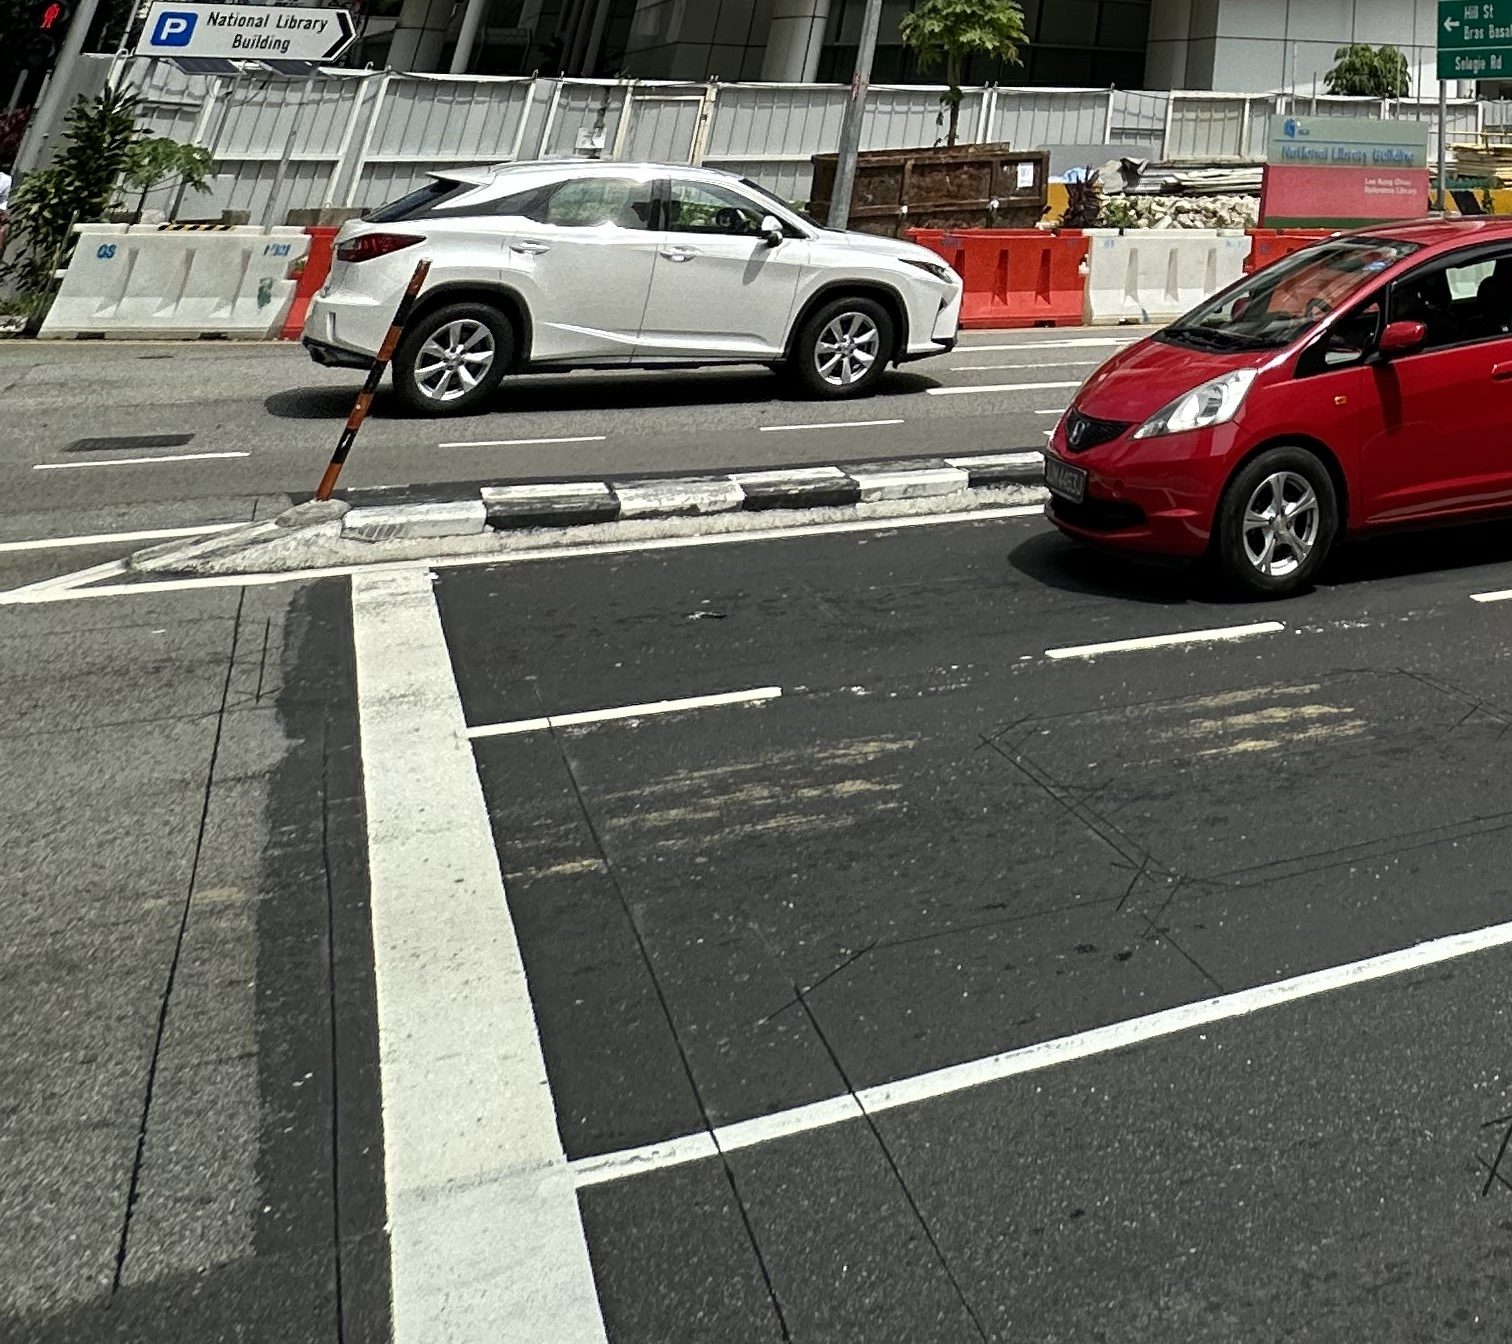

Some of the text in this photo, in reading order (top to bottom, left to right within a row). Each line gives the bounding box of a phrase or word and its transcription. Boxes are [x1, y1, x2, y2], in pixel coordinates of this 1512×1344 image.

[1483, 4, 1494, 19] St
[159, 18, 188, 41] P
[206, 12, 329, 34] National Library
[1464, 25, 1485, 40] Bras
[231, 34, 291, 53] Building
[1490, 54, 1502, 70] Rd
